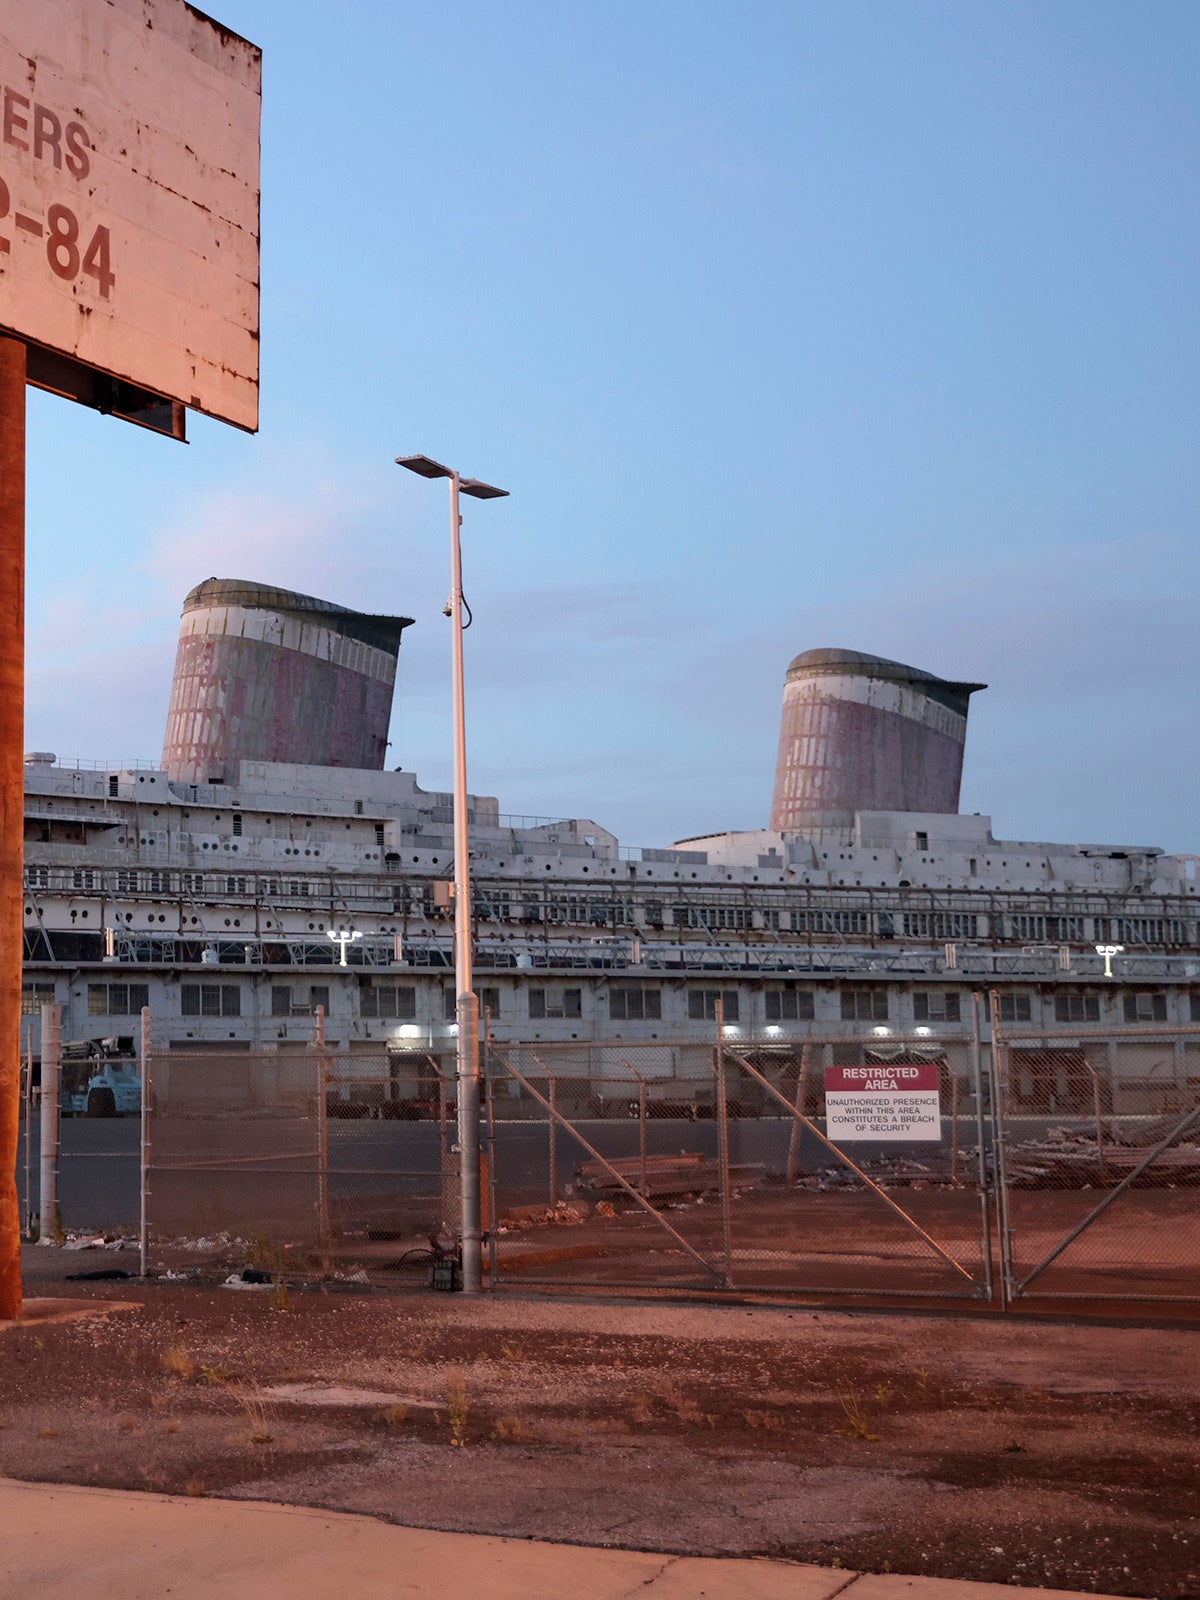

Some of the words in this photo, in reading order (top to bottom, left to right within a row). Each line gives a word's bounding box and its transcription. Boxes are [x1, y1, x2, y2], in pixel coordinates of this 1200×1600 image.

[842, 1067, 919, 1079] RESTRICTED
[864, 1079, 898, 1090] AREA
[827, 1098, 890, 1106] UNAUTHORIZED
[893, 1098, 937, 1106] PRESENCE
[832, 1115, 888, 1123] CONSTITUTES
[900, 1115, 935, 1123] BREACH
[855, 1124, 868, 1132] OF
[870, 1124, 911, 1132] SECURITY
